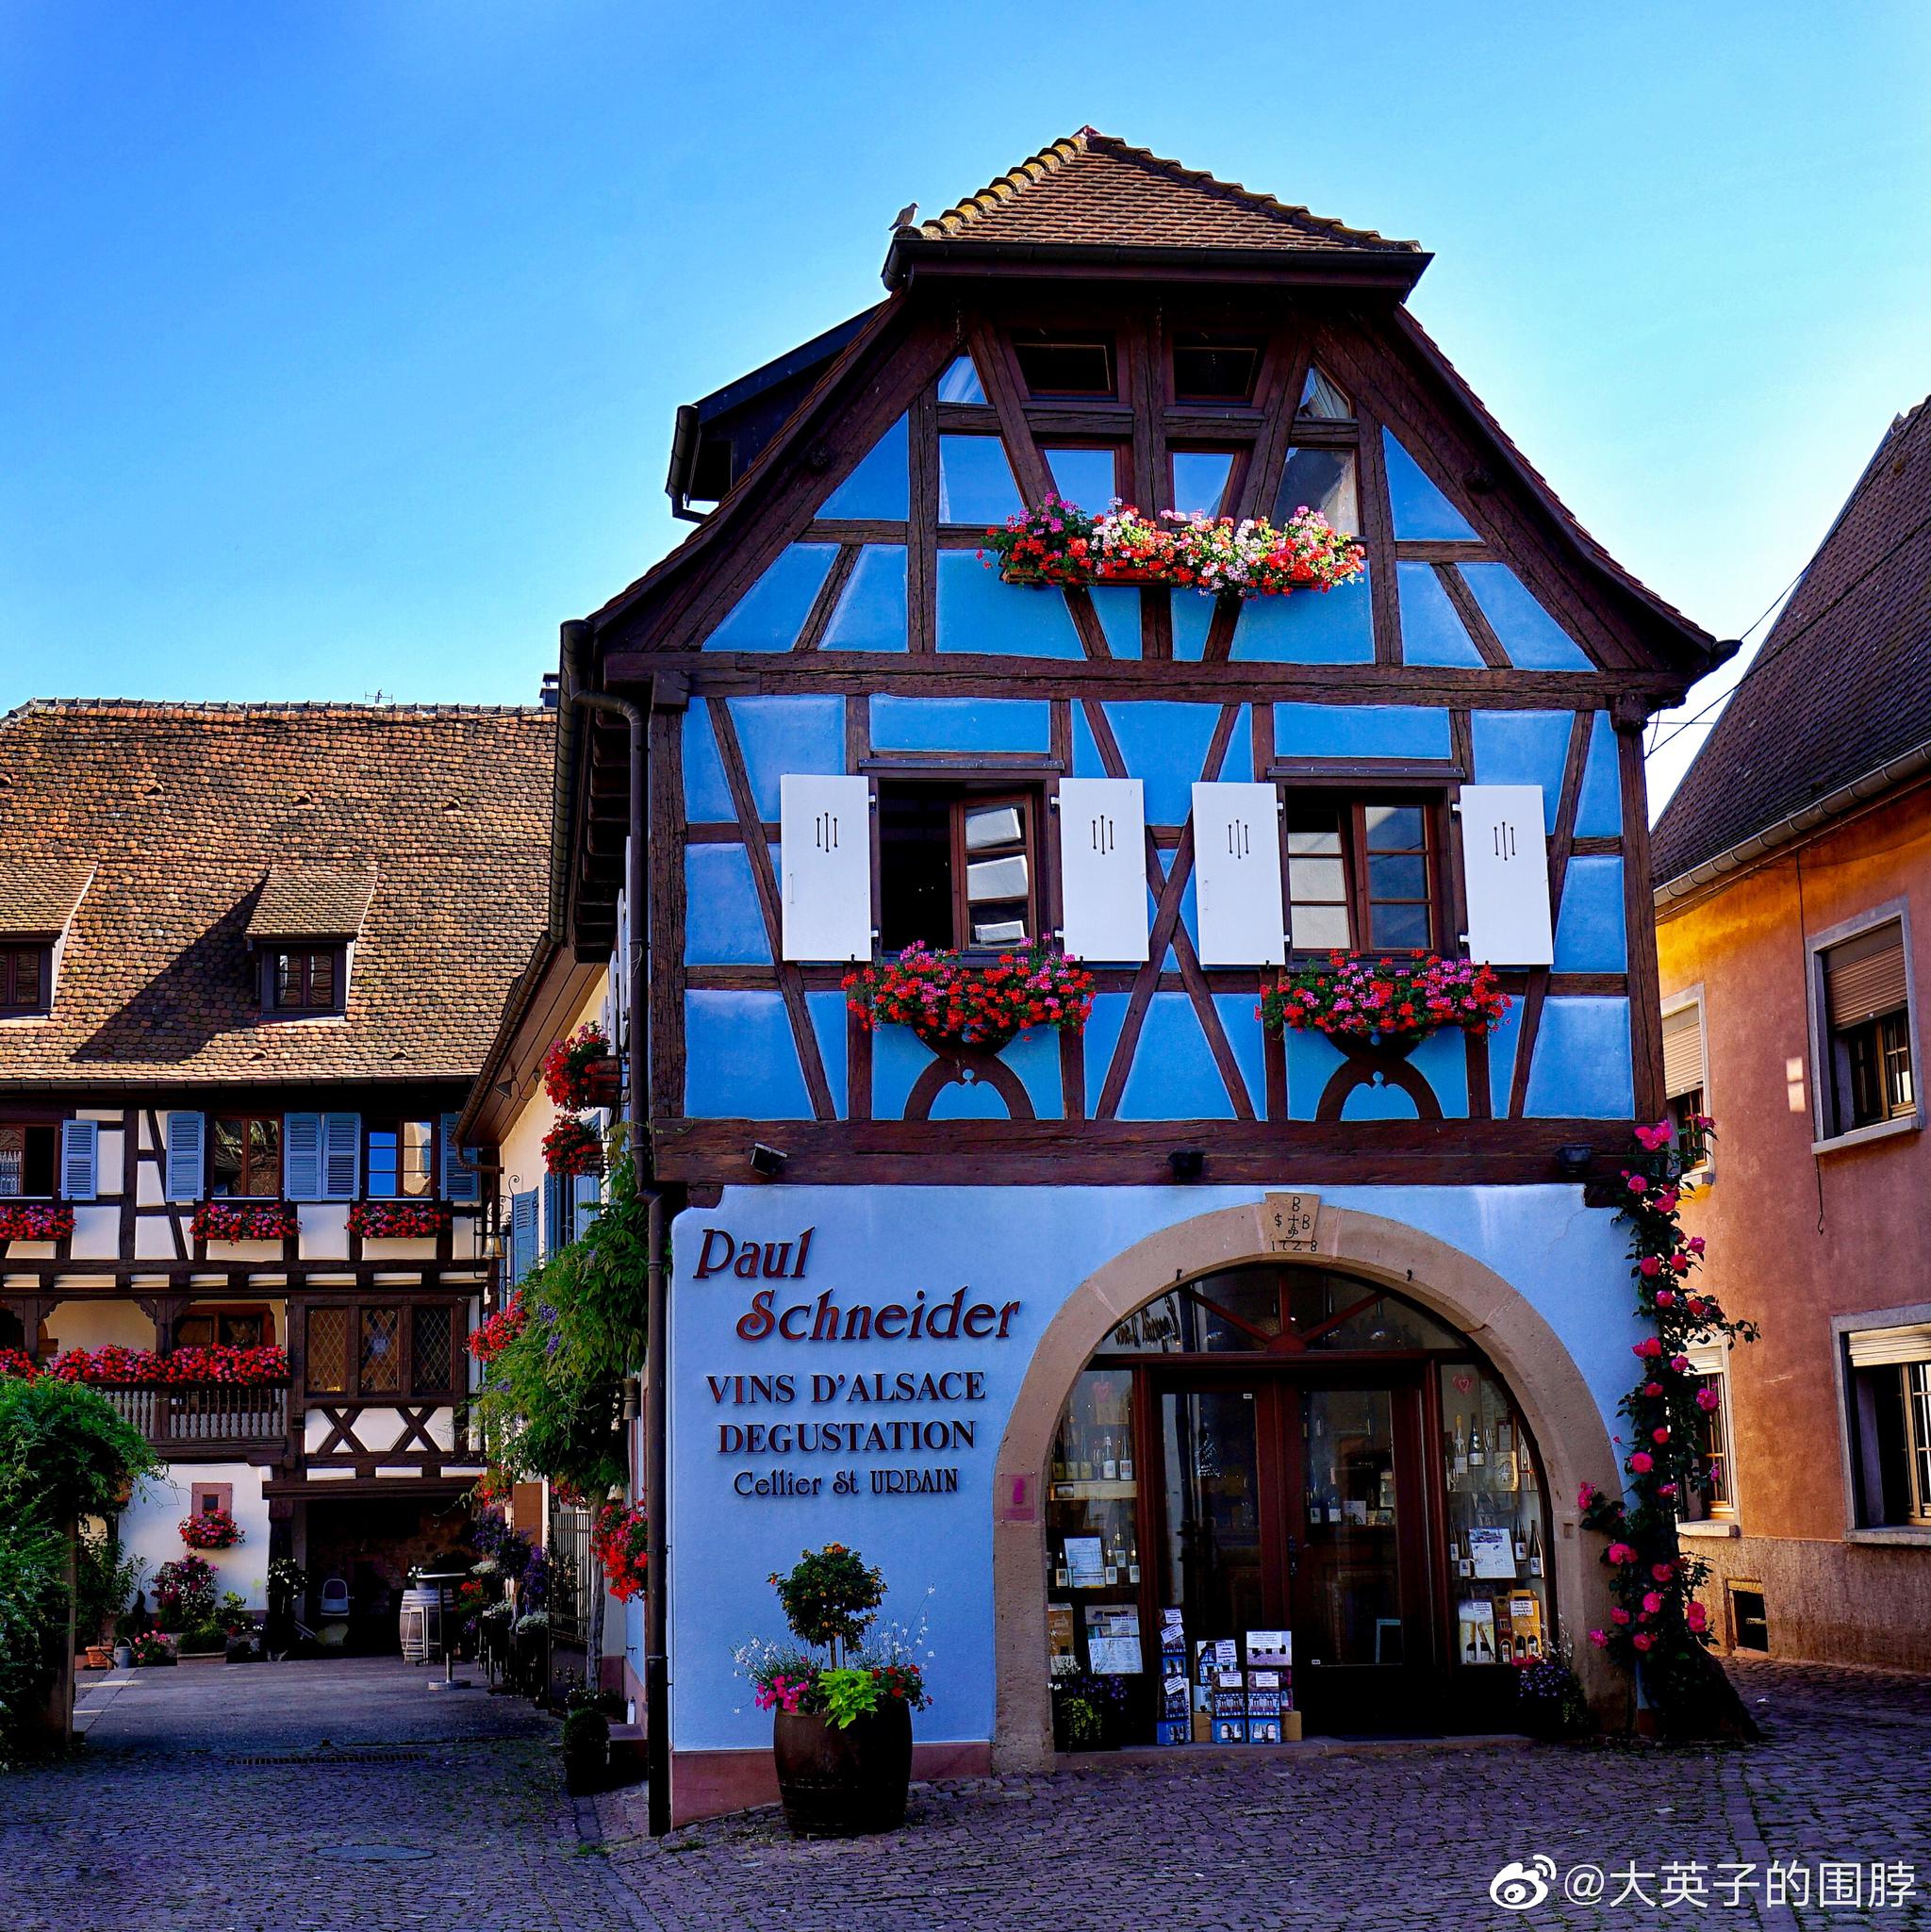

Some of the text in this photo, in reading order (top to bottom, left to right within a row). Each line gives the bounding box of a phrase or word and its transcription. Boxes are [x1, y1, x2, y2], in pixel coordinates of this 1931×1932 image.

[692, 1226, 816, 1280] Paul
[735, 1284, 1021, 1342] Schneider
[705, 1371, 987, 1405] VINS D'ALSACE
[717, 1419, 977, 1454] DEGUSTATION
[734, 1467, 959, 1496] Cellier St URBAIN
